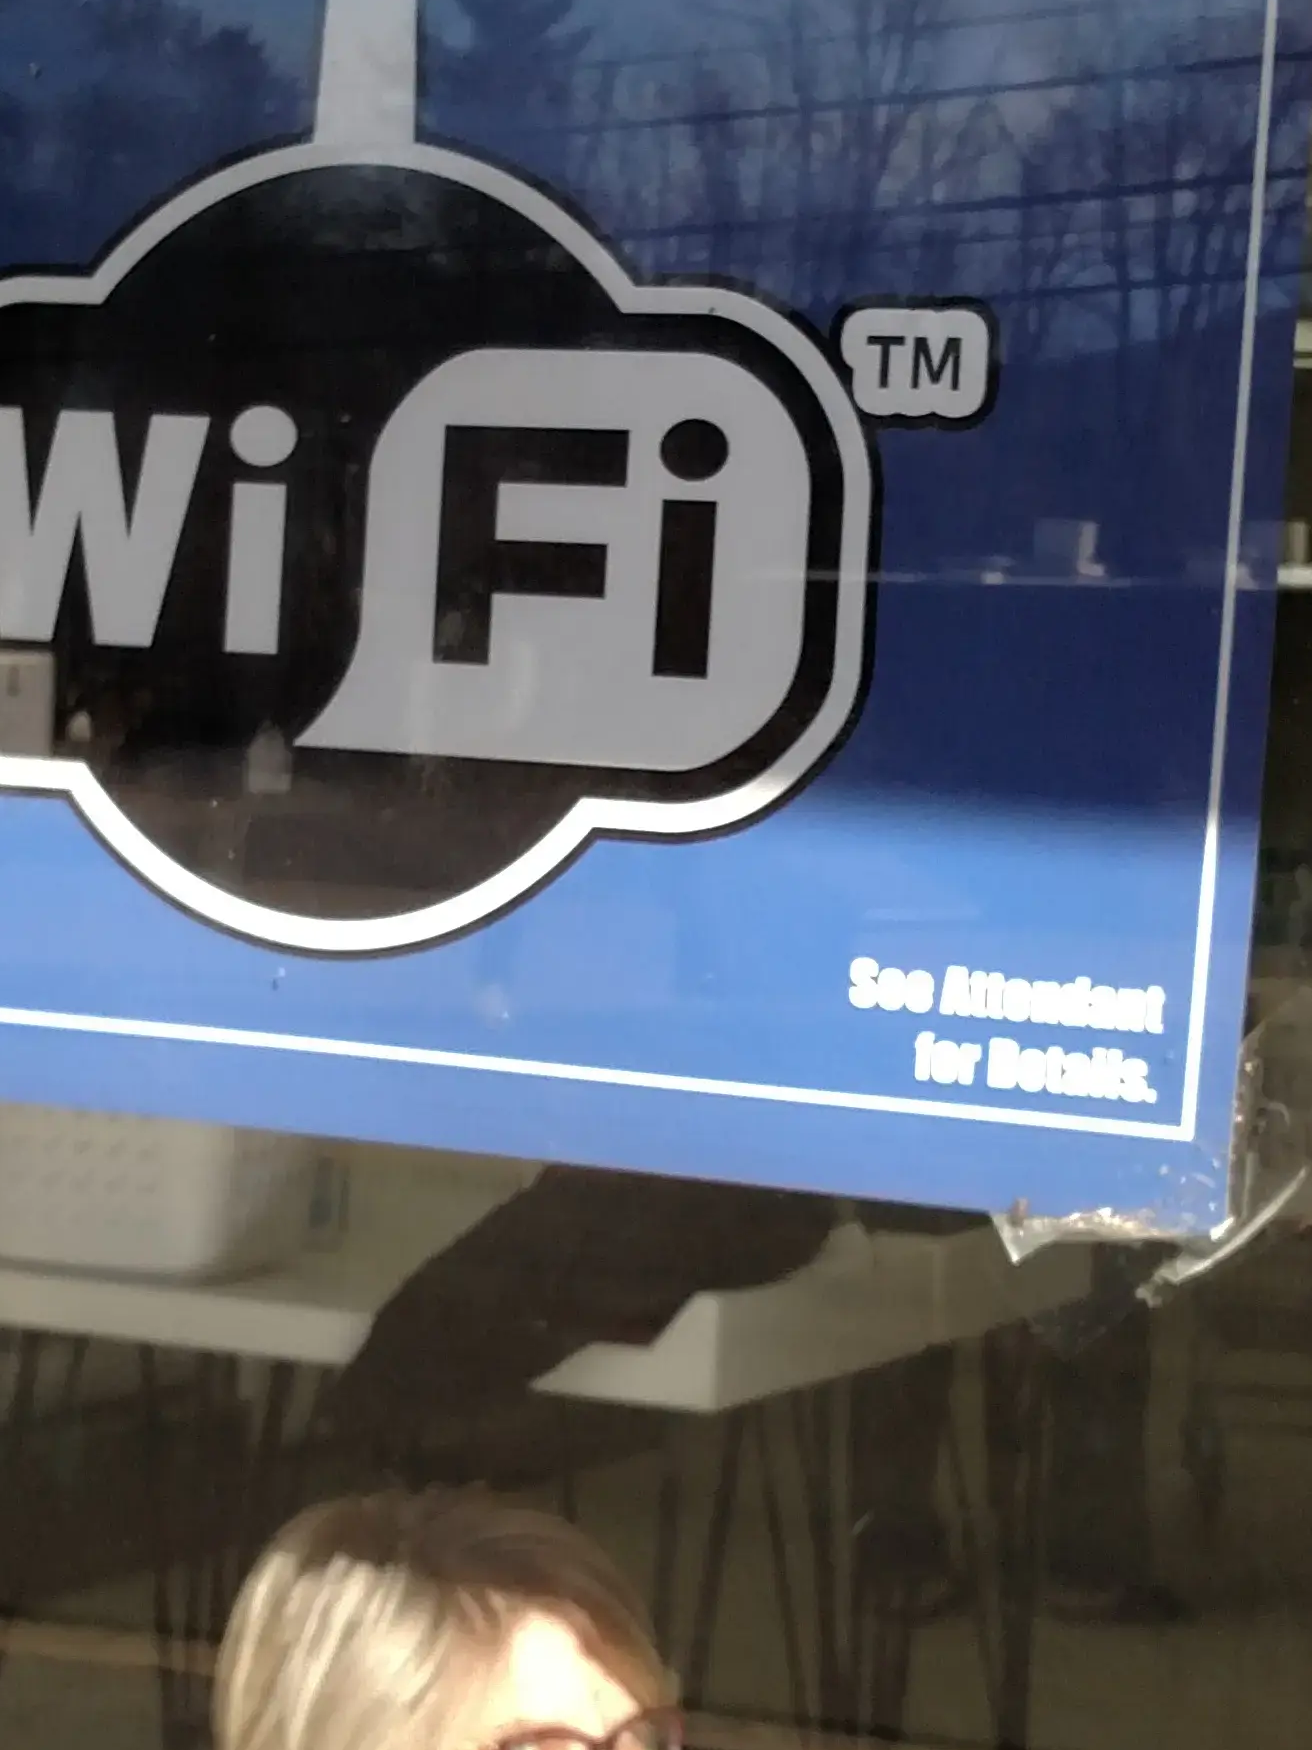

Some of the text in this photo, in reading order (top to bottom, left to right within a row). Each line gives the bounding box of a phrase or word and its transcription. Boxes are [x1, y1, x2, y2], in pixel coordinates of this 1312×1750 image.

[866, 334, 963, 392] TM
[848, 956, 1166, 1034] See Attendant
[914, 1030, 1158, 1105] for Details.
